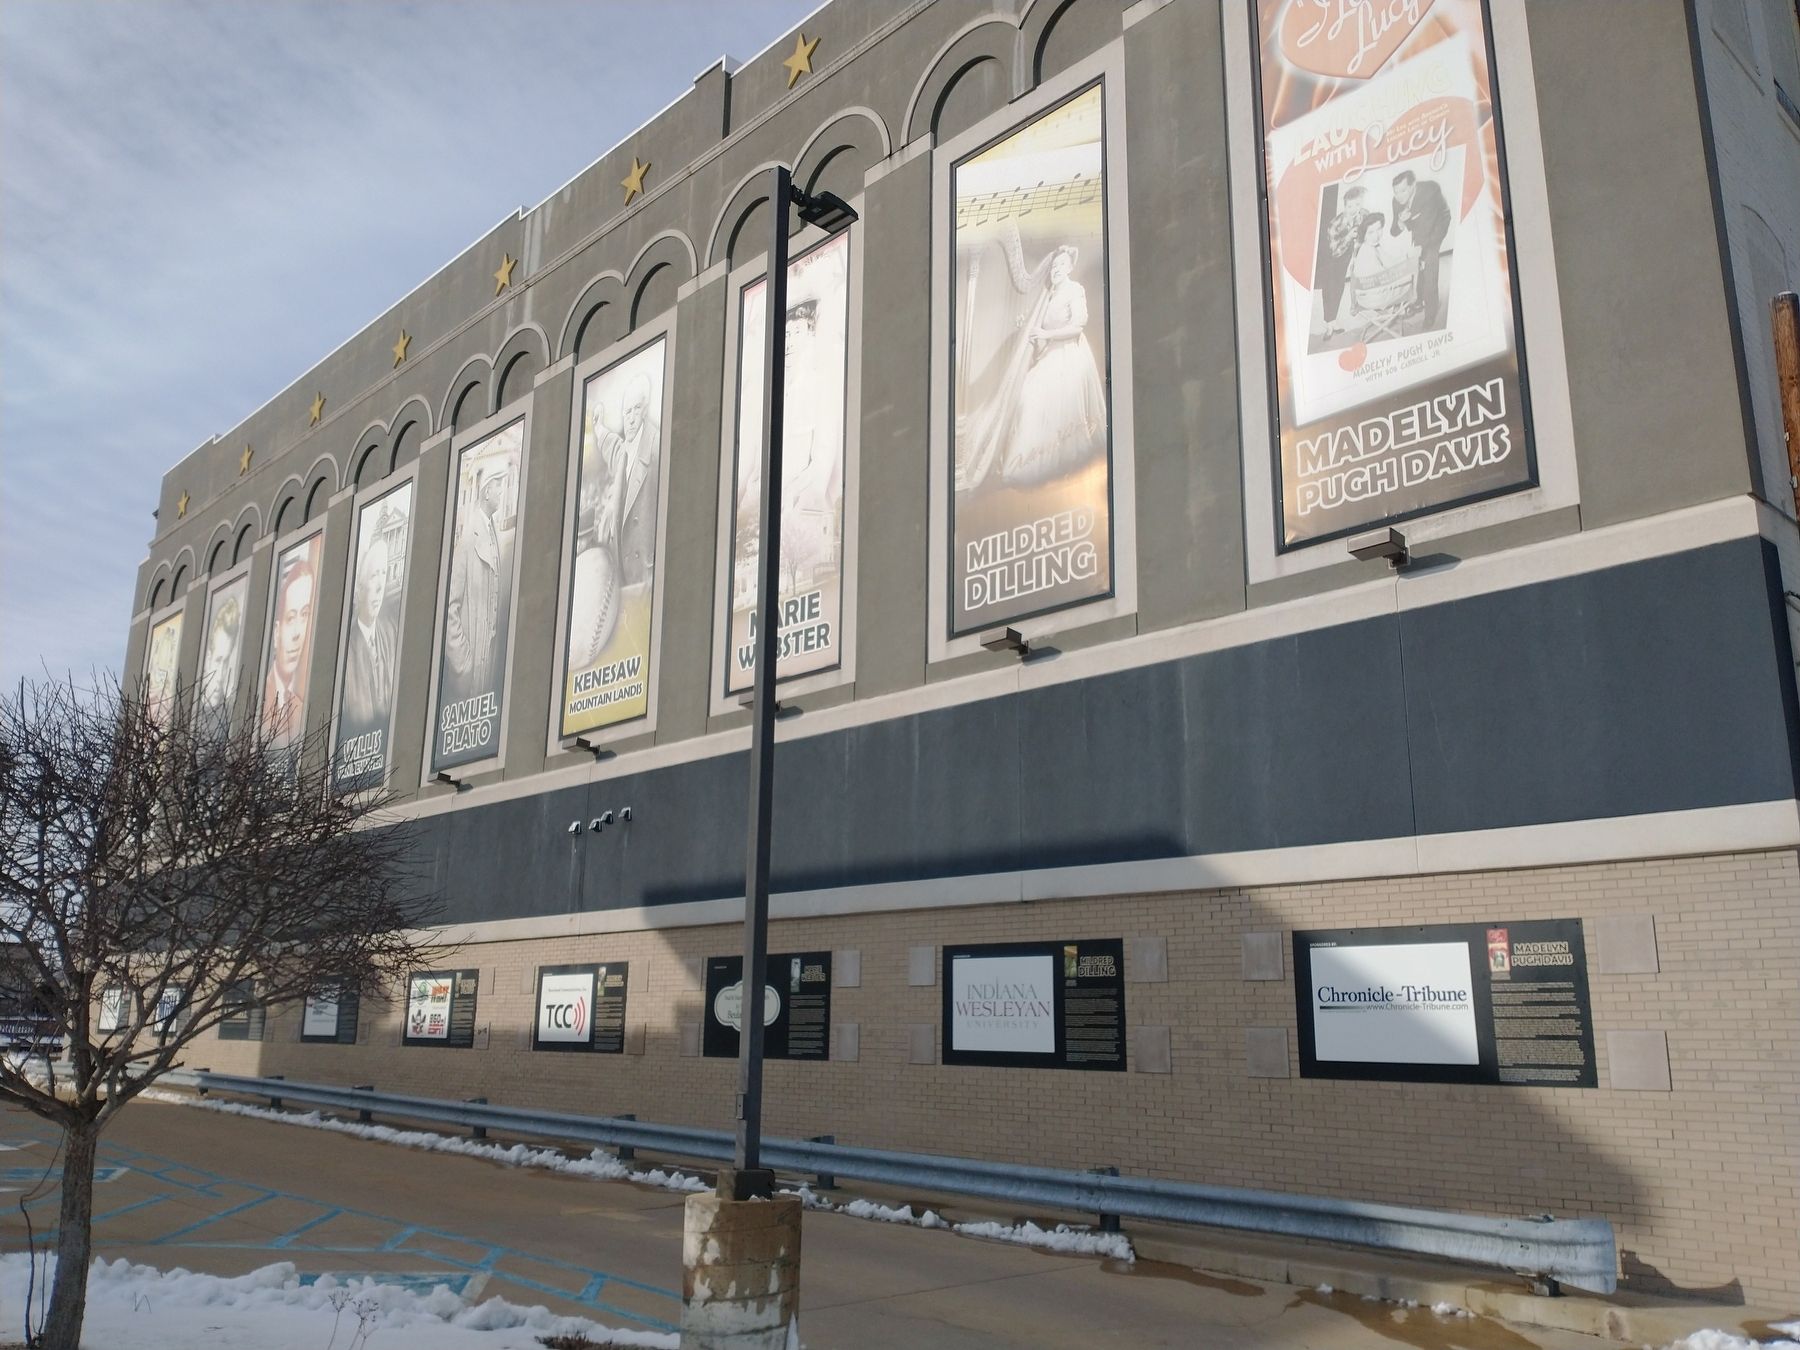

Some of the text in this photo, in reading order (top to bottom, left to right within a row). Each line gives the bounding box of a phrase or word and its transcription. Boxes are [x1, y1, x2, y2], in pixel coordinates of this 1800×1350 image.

[1314, 137, 1358, 174] WITH
[1344, 117, 1455, 184] Lucy
[1352, 331, 1454, 379] MADELYN PUGH DAVIS
[1295, 376, 1507, 478] MADELYN
[1296, 424, 1512, 516] PUGH DAVIS
[966, 506, 1095, 574] MILDRED
[964, 540, 1098, 612] DILLING
[737, 622, 831, 672] WBSTER
[573, 654, 643, 695] KENESAW
[441, 691, 498, 732] SAMUEL
[568, 681, 644, 716] MOUNTAIN LANDIS
[442, 718, 492, 755] PLATO
[1079, 955, 1114, 966] MILDRED
[1511, 953, 1574, 967] PUGH DAVIS
[1513, 941, 1569, 955] MADELYN
[967, 976, 1038, 1000] INDIANA
[1078, 965, 1117, 978] DILLING
[955, 1000, 1051, 1018] WESLEYAN
[1317, 985, 1468, 1003] Chronicle-Tribune
[1366, 1002, 1469, 1012] www.Chronicle-Tribune.com
[546, 1003, 574, 1029] TCC
[966, 1019, 1040, 1031] UNIVERSITY
